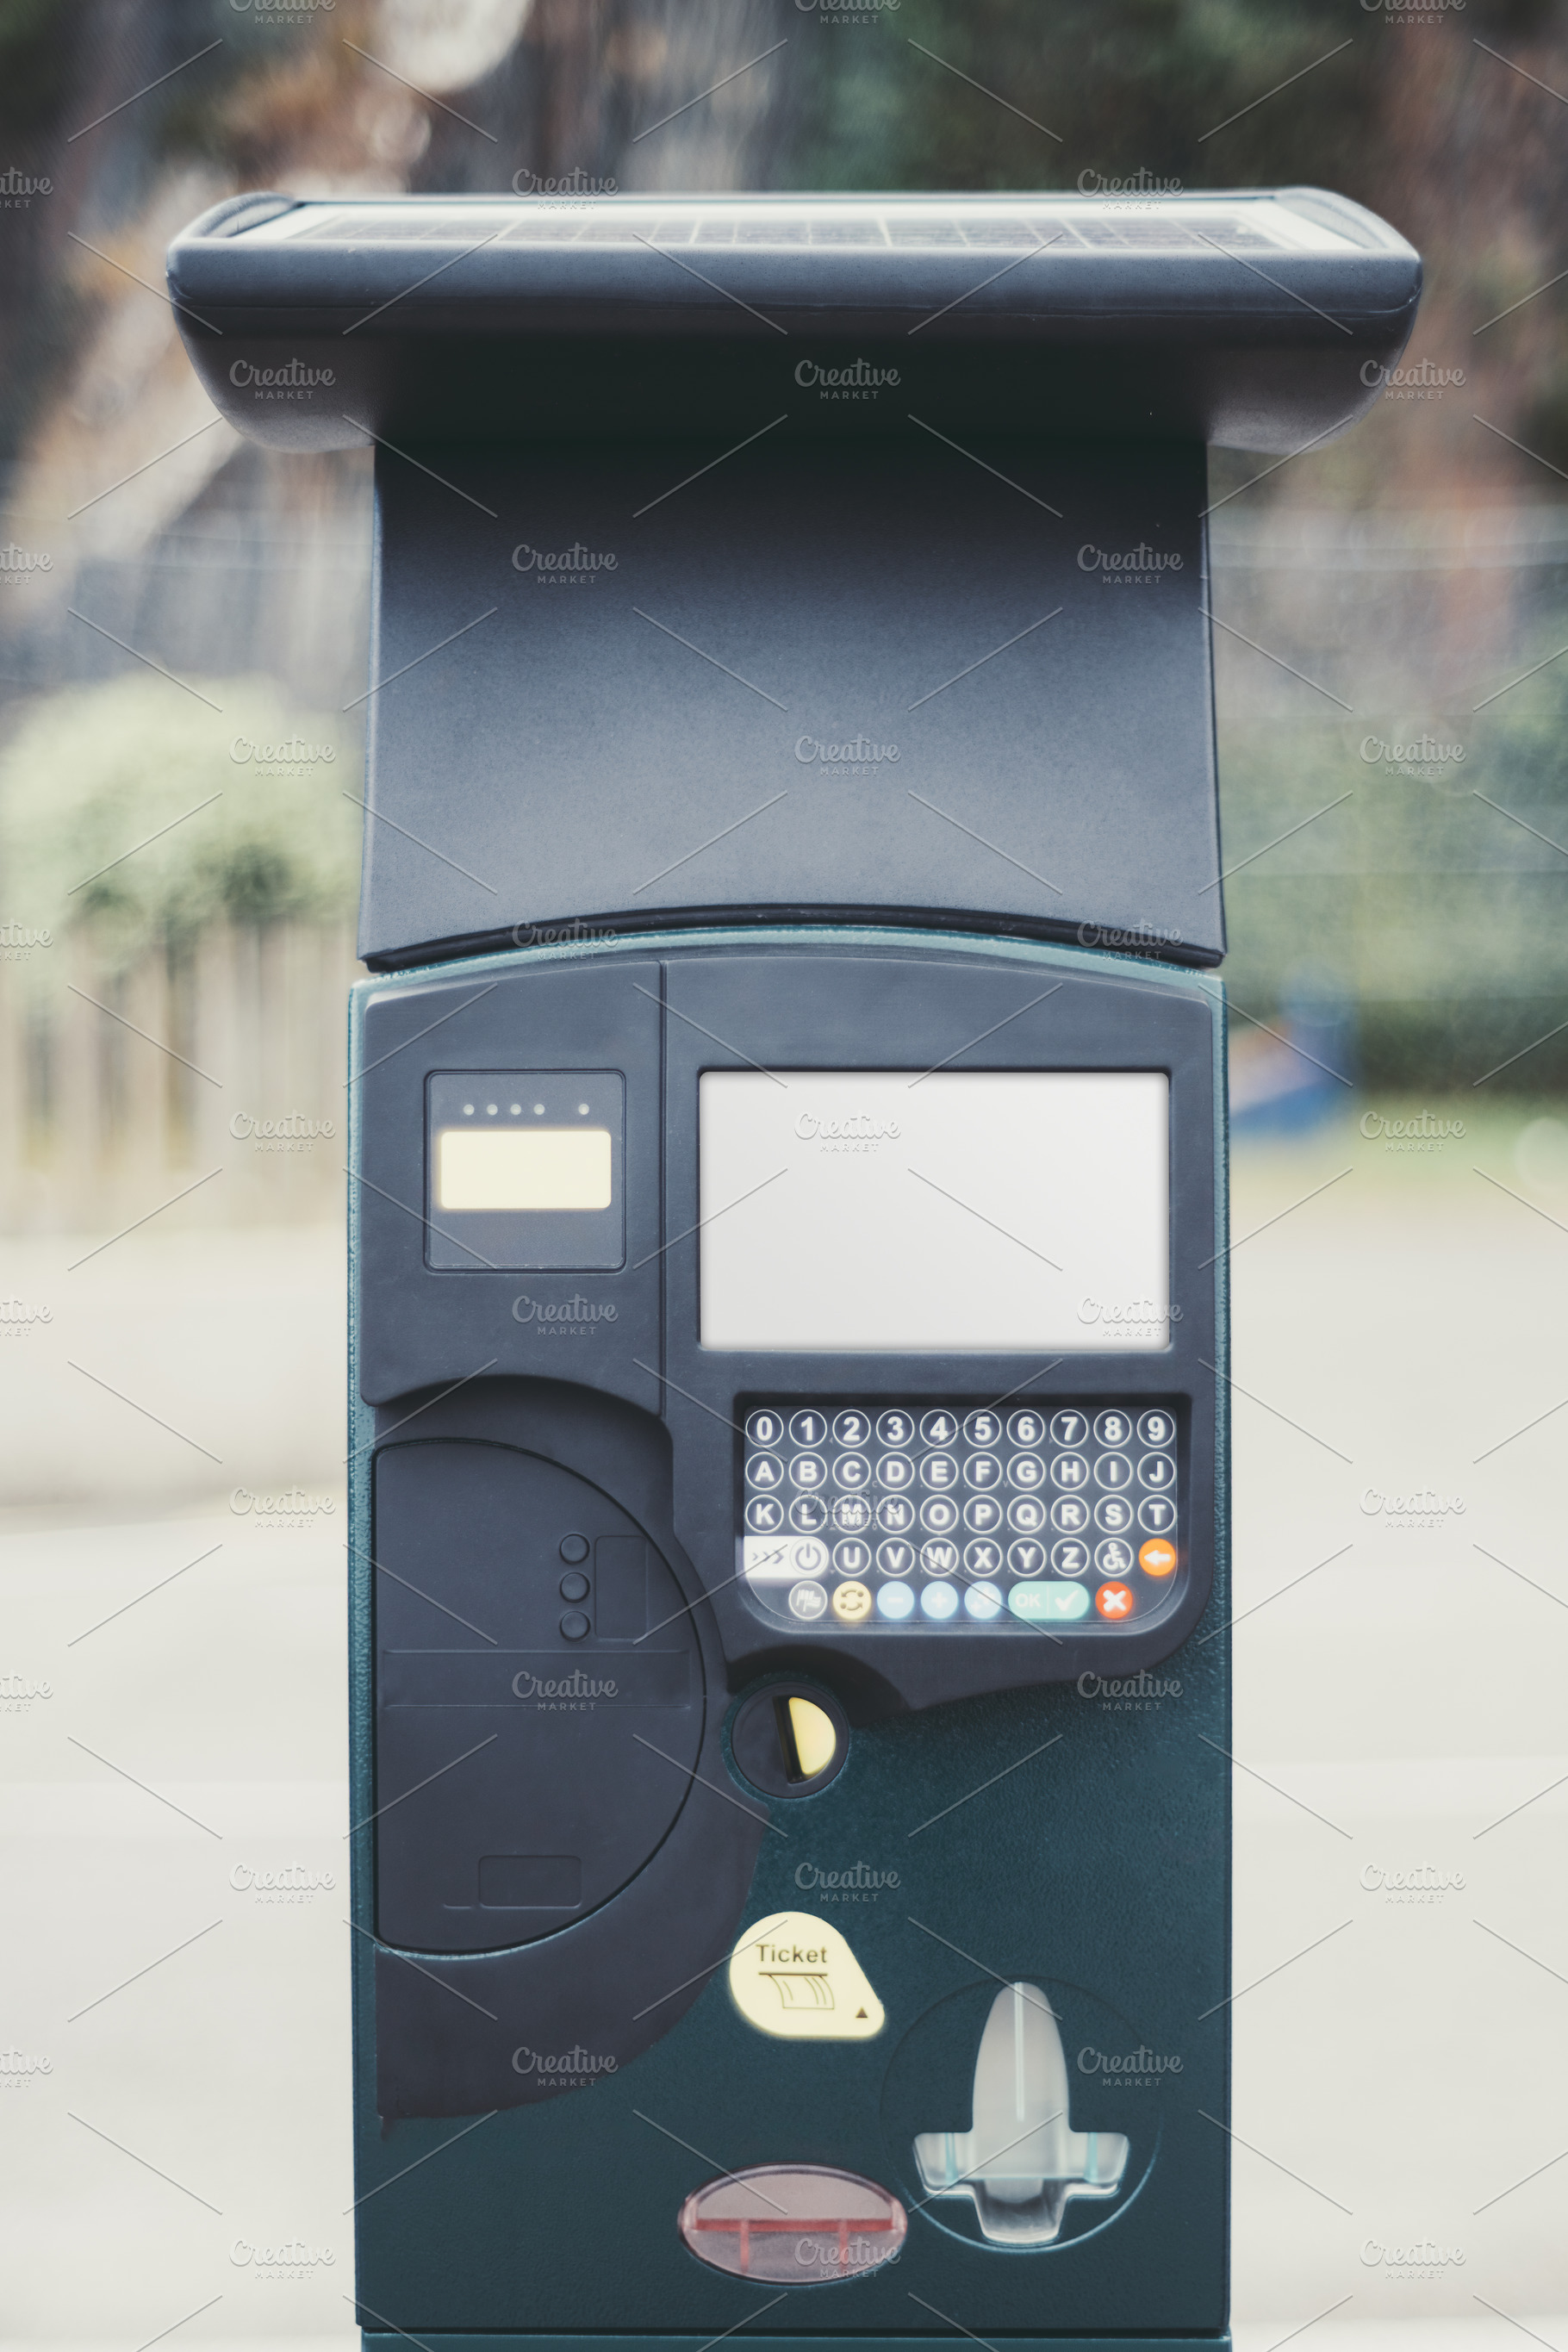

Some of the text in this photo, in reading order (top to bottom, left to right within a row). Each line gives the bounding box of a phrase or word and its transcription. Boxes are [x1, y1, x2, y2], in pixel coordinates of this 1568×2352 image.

[801, 1417, 812, 1440] 1
[843, 1417, 860, 1440] 2
[887, 1417, 903, 1440] 3
[930, 1417, 948, 1440] 4
[975, 1417, 991, 1440] 5
[1018, 1417, 1035, 1440] 6
[1061, 1417, 1077, 1440] 7
[1105, 1417, 1121, 1440] 8
[1148, 1417, 1164, 1440] 9
[756, 1461, 1163, 1482] A B C D E F G H I J
[756, 1503, 1166, 1527] K L M N O P Q R S T
[843, 1547, 1079, 1569] U V W X Y Z
[1015, 1593, 1041, 1608] OK
[756, 1944, 827, 1963] Ticket
